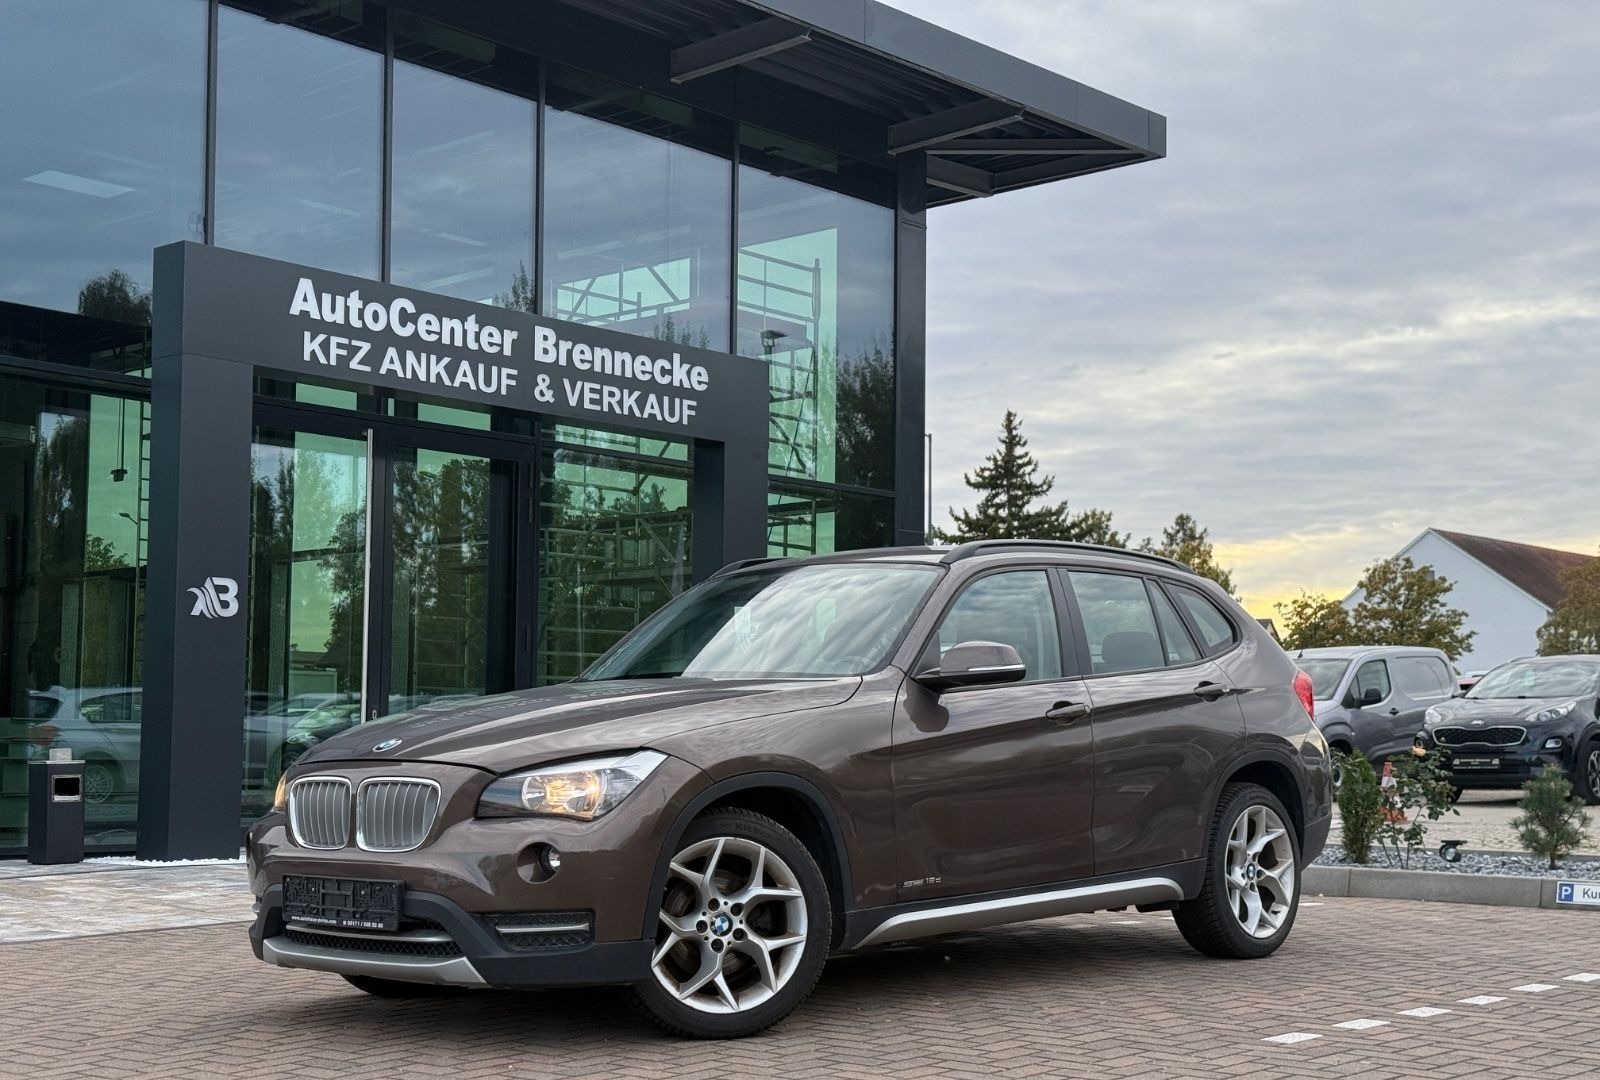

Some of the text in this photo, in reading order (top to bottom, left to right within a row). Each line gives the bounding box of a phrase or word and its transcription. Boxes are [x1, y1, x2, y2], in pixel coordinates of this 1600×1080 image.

[289, 278, 709, 391] AutoCenter Brennecke
[303, 331, 698, 425] KFZ ANKAUF & VERKAUF
[1561, 886, 1600, 900] P Ku
